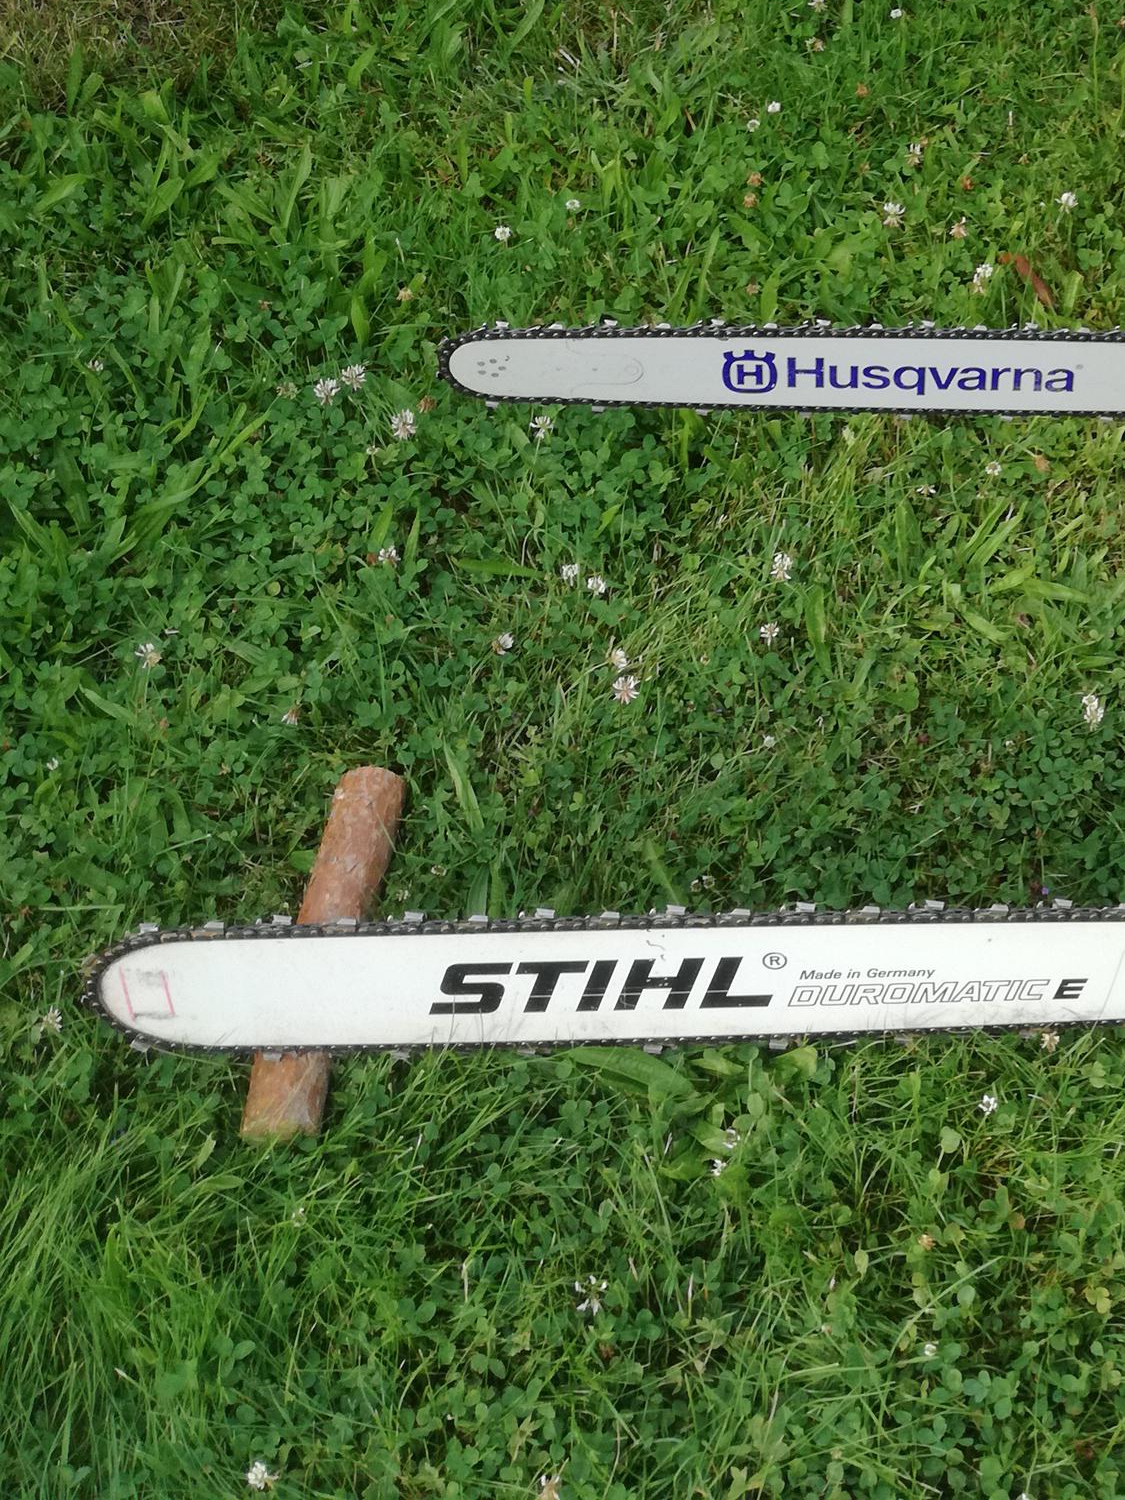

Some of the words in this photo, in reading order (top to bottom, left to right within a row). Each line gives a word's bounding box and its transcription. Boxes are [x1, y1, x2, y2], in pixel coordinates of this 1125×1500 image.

[786, 356, 1076, 396] Husqvarna
[429, 956, 774, 1015] STIHL
[799, 968, 842, 980] Made
[847, 968, 861, 979] in
[866, 967, 936, 980] Germany
[787, 979, 1050, 1007] DUROMATIC
